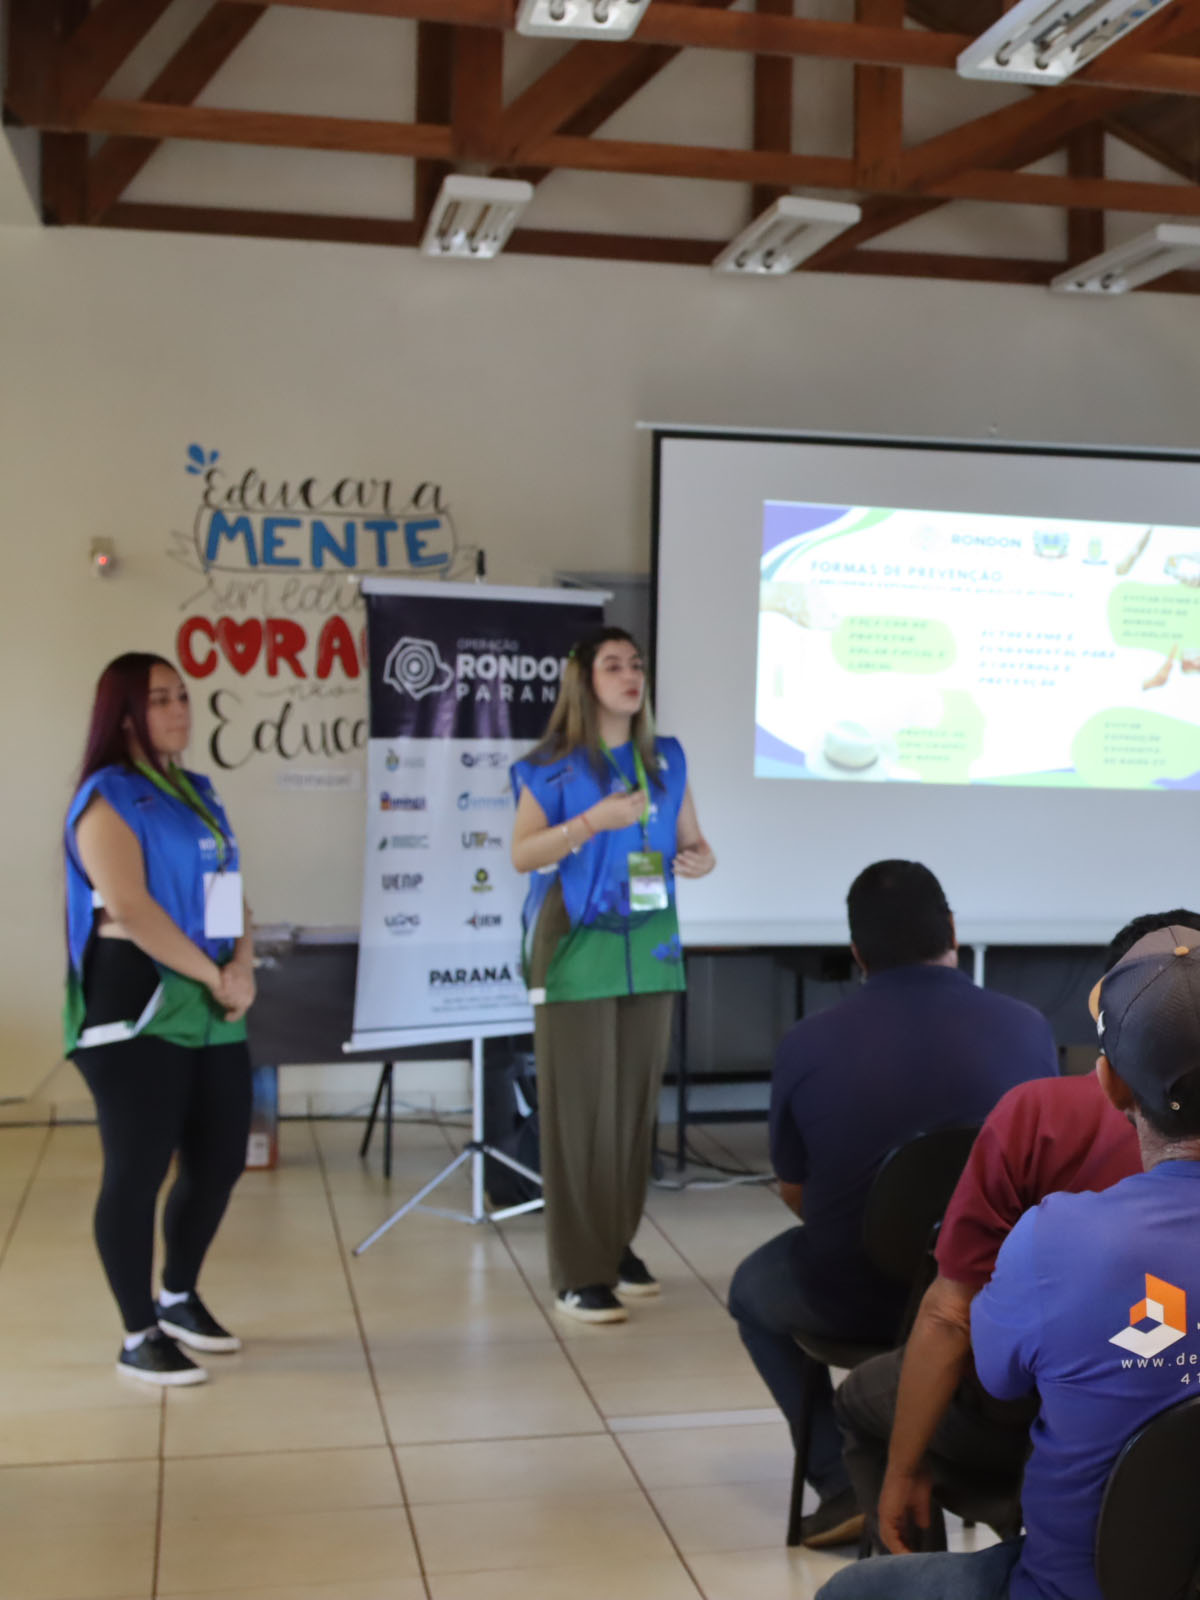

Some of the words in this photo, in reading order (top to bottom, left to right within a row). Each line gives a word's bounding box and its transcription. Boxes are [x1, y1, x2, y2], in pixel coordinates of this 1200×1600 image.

[205, 509, 449, 569] MENTE
[810, 560, 877, 575] FORMAS
[884, 564, 901, 576] DE
[429, 963, 511, 986] PARANÁ
